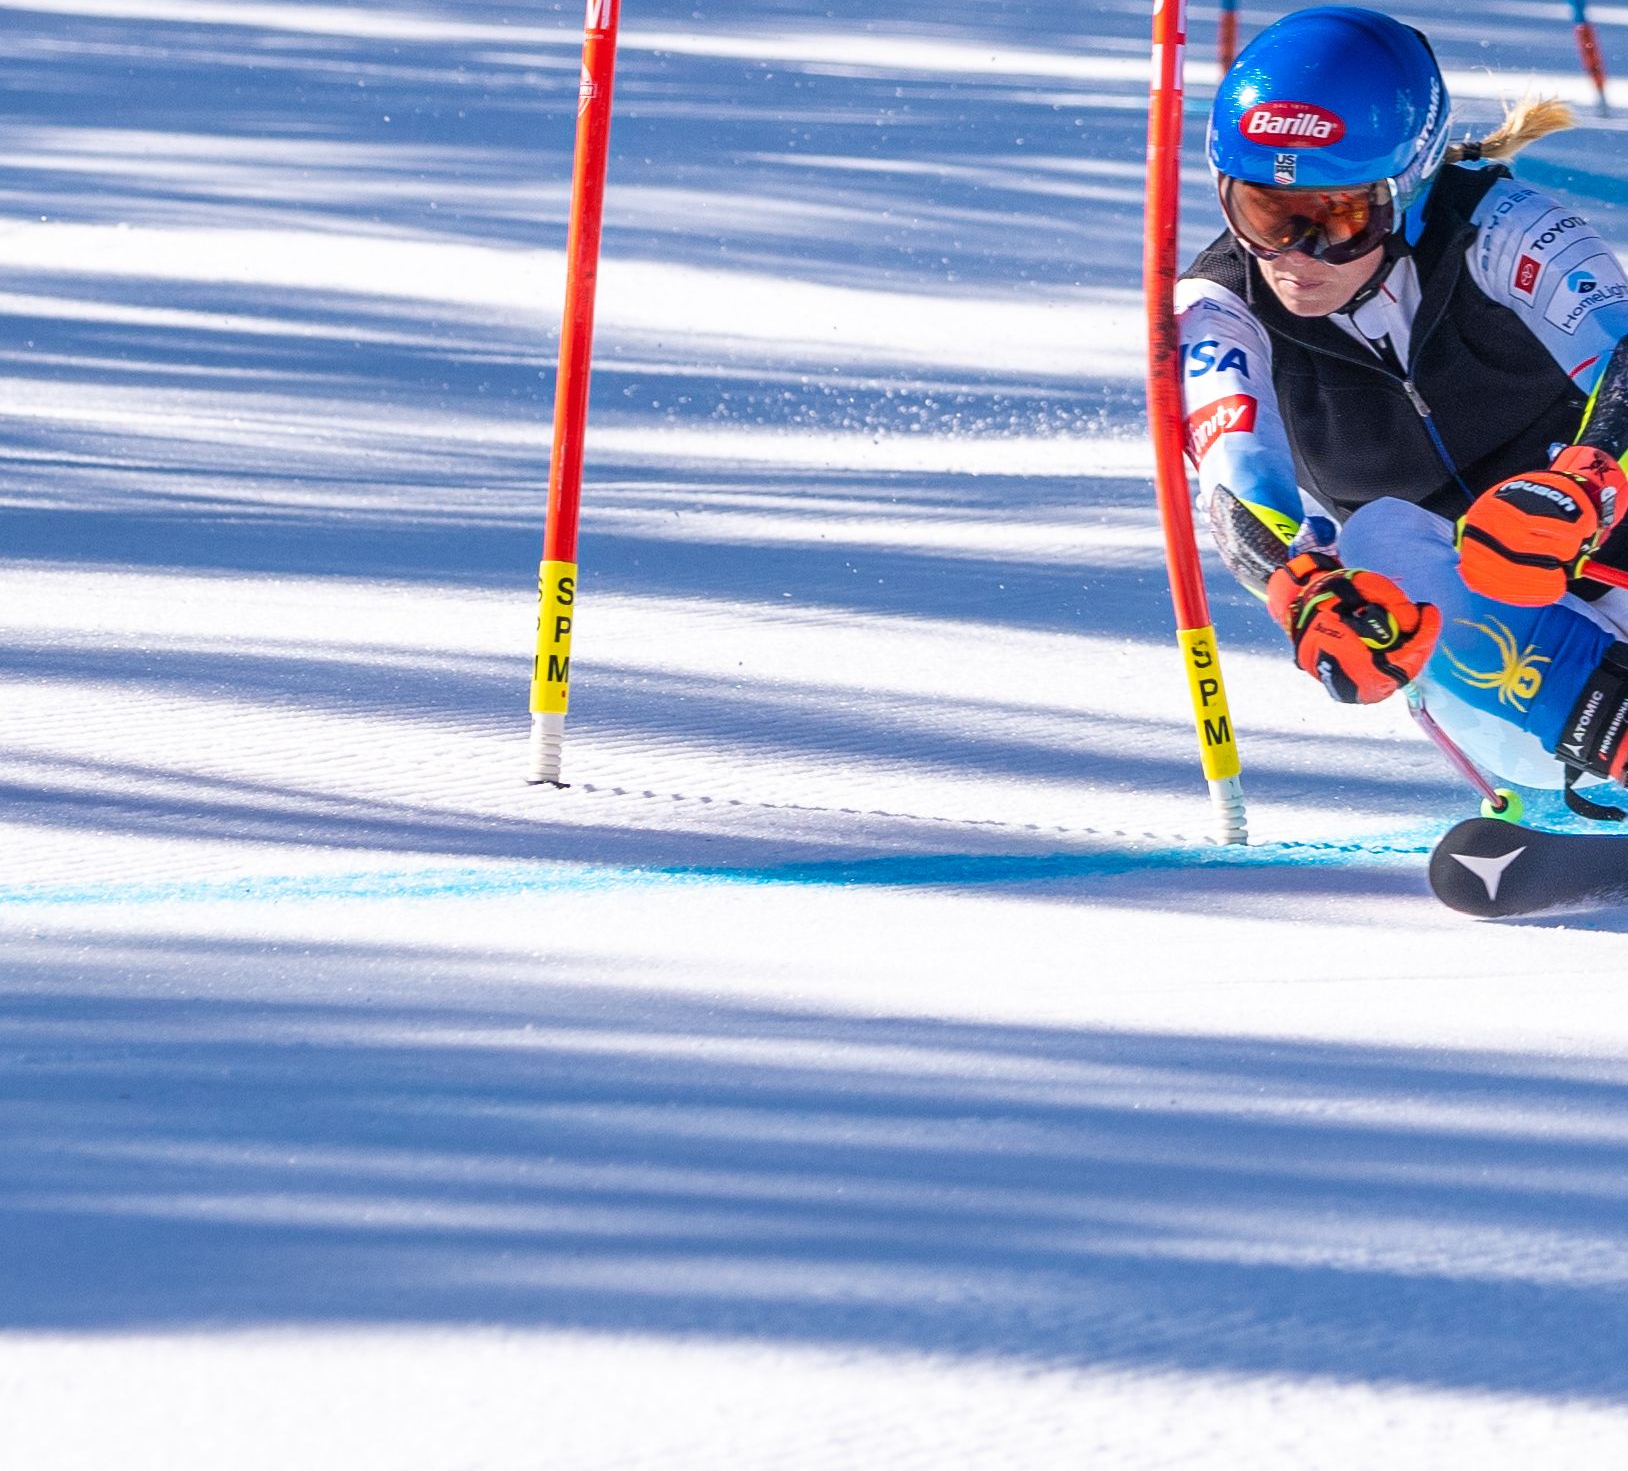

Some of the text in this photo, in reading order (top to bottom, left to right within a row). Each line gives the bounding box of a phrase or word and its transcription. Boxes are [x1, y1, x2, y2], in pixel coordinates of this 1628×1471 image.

[1247, 111, 1334, 139] Barilla
[1275, 154, 1296, 166] US
[1191, 640, 1232, 747] SPM
[1572, 690, 1605, 743] ATOMIC
